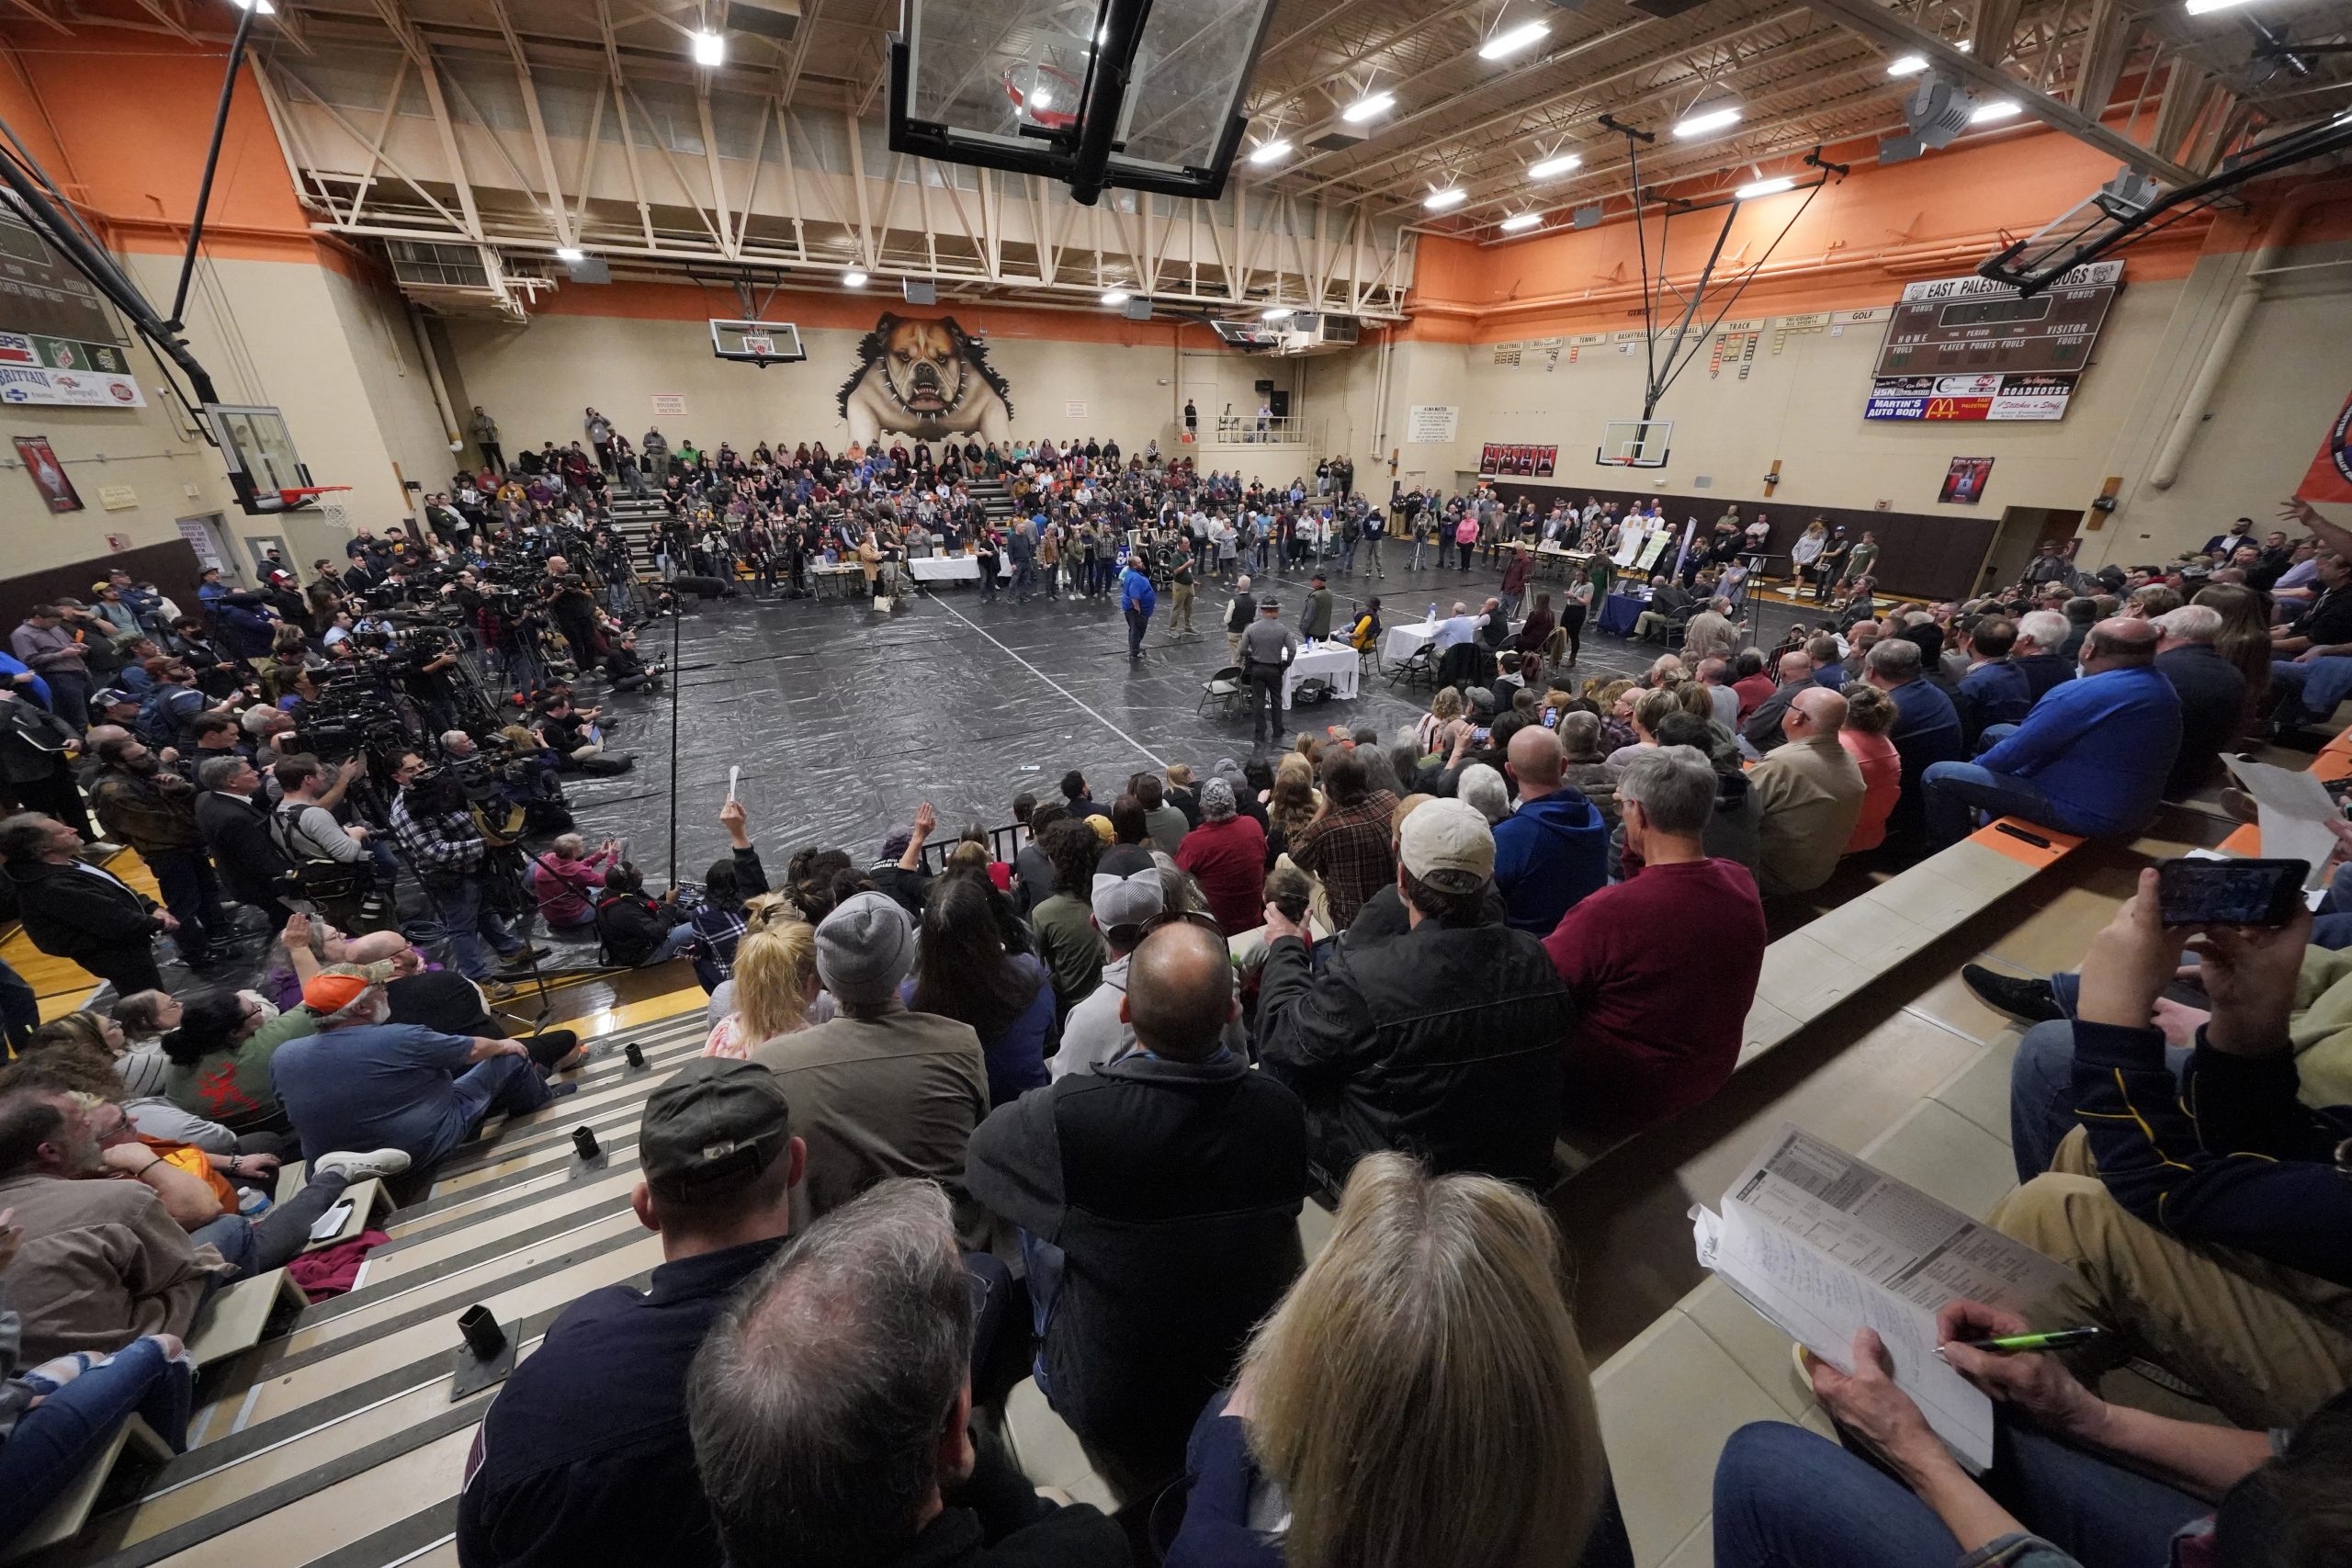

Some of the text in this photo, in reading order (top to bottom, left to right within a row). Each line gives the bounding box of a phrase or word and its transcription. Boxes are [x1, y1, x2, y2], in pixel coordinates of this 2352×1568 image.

[1928, 282, 1955, 298] EAST
[2066, 290, 2096, 300] BONUS
[1911, 304, 1933, 313] BONUS
[1853, 311, 1873, 320] GOLF
[1729, 321, 1750, 331] TRACK
[2046, 323, 2088, 334] VISITOR
[1966, 329, 1990, 337] PERIOD
[1897, 333, 1928, 344] HOME
[2057, 336, 2084, 344] FOULS
[1939, 340, 2027, 351] PLAYER POINTS FOULS
[0, 369, 51, 389] BRITTAIN
[2003, 387, 2069, 396] ROADHOUSE
[1874, 399, 1922, 408] MARTIN'S
[1867, 409, 1894, 418] AUTO
[1895, 409, 1923, 417] BODY
